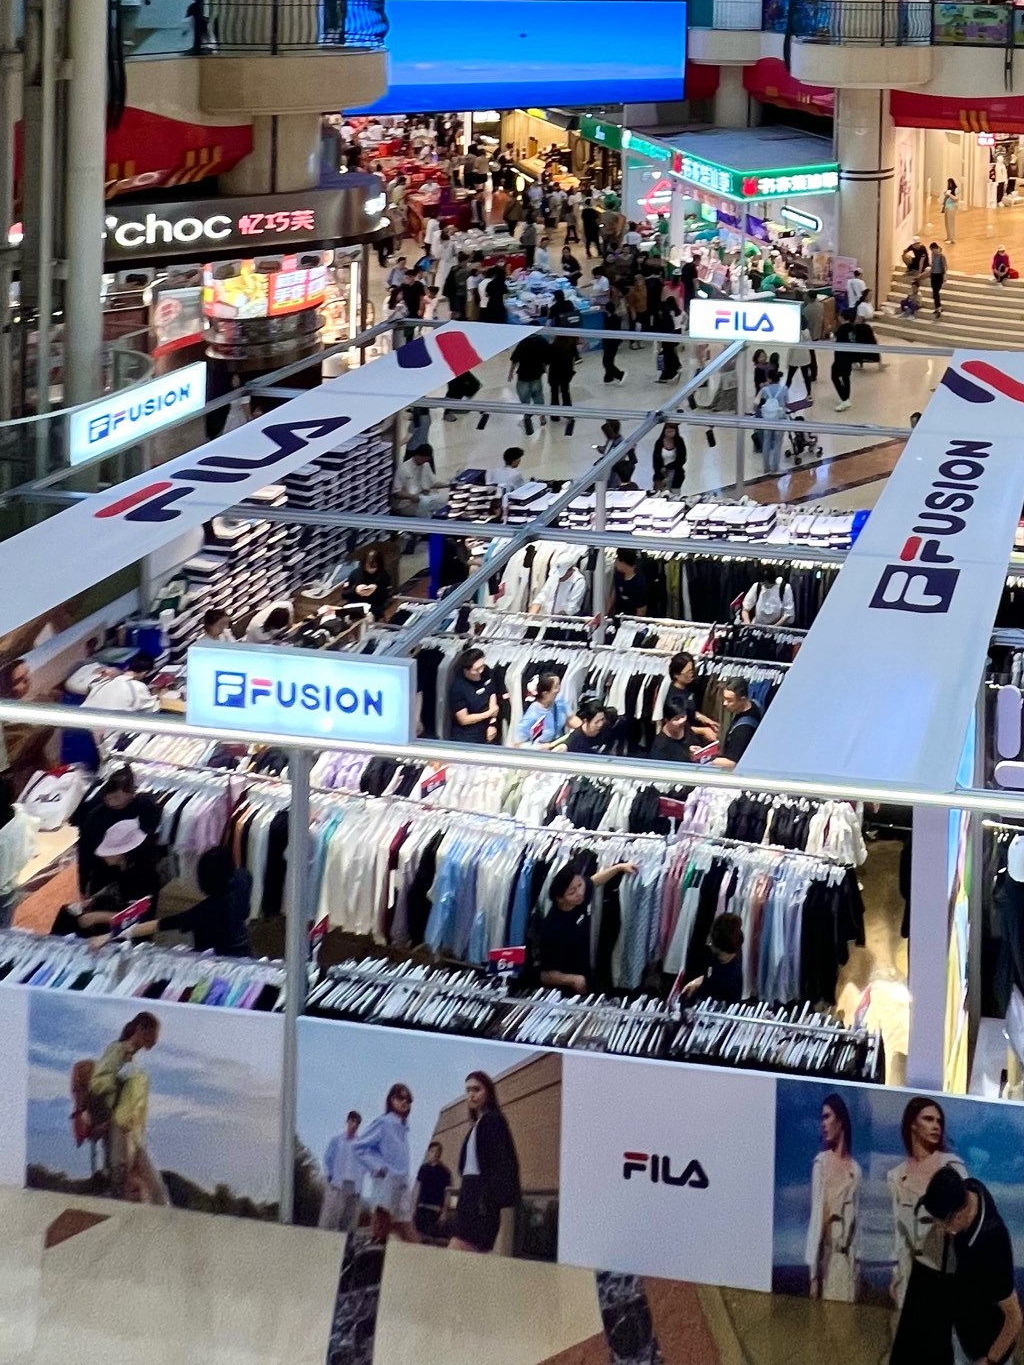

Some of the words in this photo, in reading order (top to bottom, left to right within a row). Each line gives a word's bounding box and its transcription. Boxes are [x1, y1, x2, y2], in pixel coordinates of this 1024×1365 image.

[101, 212, 233, 247] 'choc
[714, 310, 775, 333] FILA
[112, 383, 190, 430] FUSION
[94, 416, 352, 523] FILA
[899, 438, 994, 563] FUSION
[250, 678, 383, 717] FUSION
[623, 1151, 710, 1190] FILA
